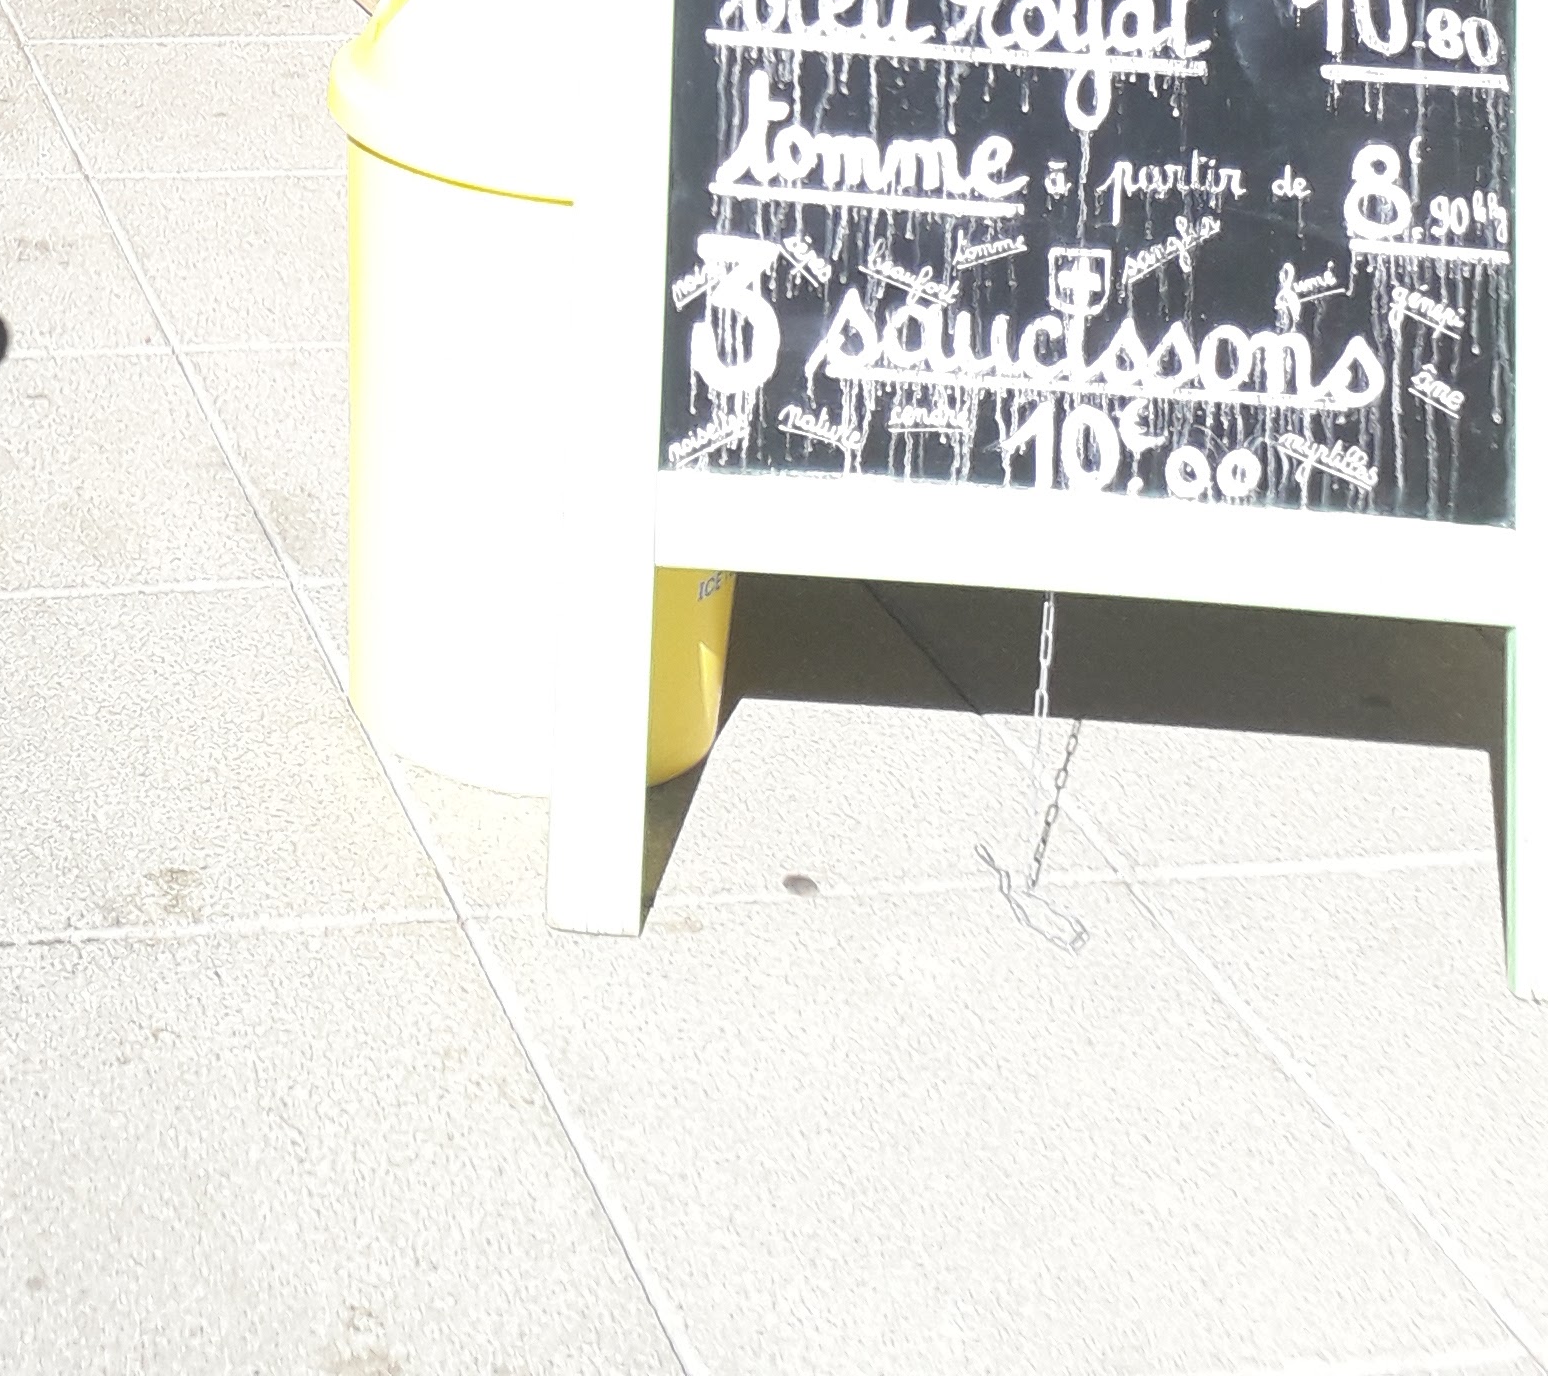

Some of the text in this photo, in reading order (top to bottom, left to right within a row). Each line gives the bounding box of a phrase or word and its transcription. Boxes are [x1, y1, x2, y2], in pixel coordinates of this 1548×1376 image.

[711, 69, 1026, 194] tomme
[1044, 161, 1073, 196] à
[1096, 150, 1247, 226] partir
[1272, 165, 1312, 198] de
[691, 234, 781, 394] 3
[806, 286, 1385, 410] saucissons
[953, 229, 1026, 266] tomme
